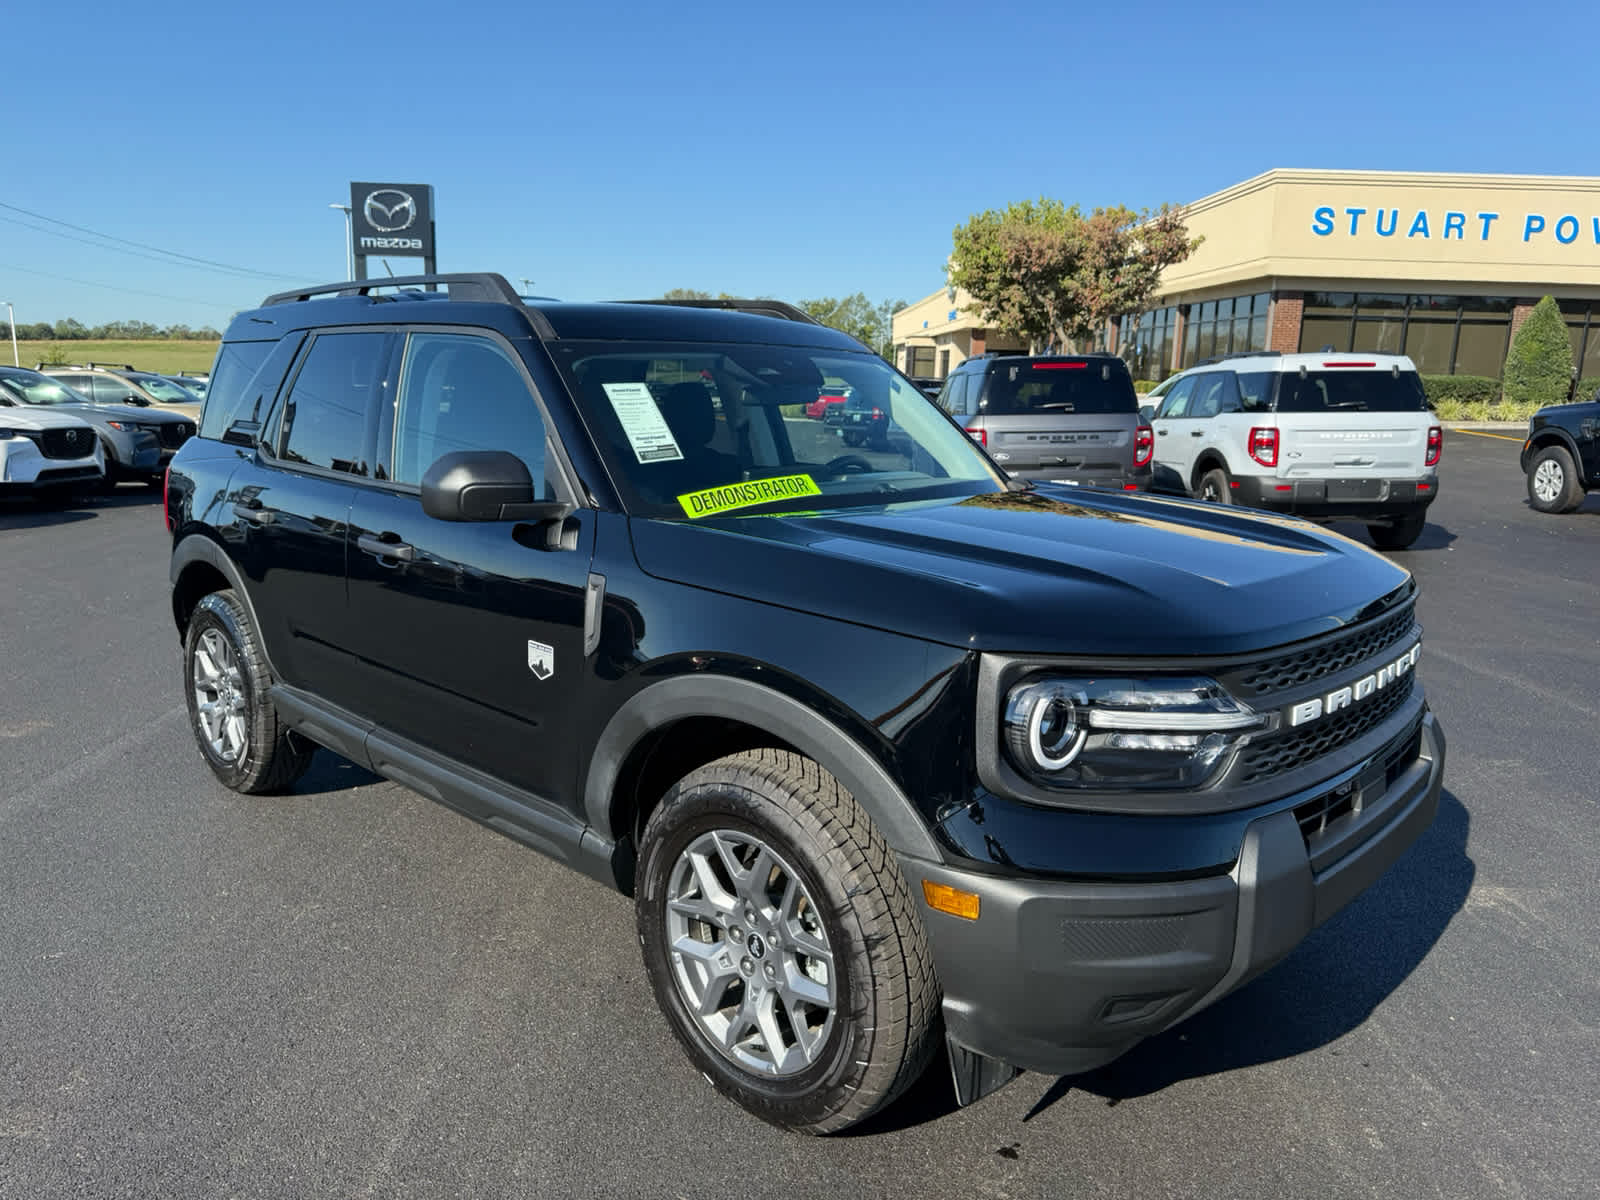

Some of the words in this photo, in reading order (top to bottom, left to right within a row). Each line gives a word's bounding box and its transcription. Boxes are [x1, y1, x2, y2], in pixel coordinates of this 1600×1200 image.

[360, 237, 423, 249] mazda
[1311, 206, 1499, 241] STUART
[1521, 214, 1600, 245] PO
[689, 476, 809, 513] DEMONSTRATOR
[1291, 642, 1421, 727] BRONCO
